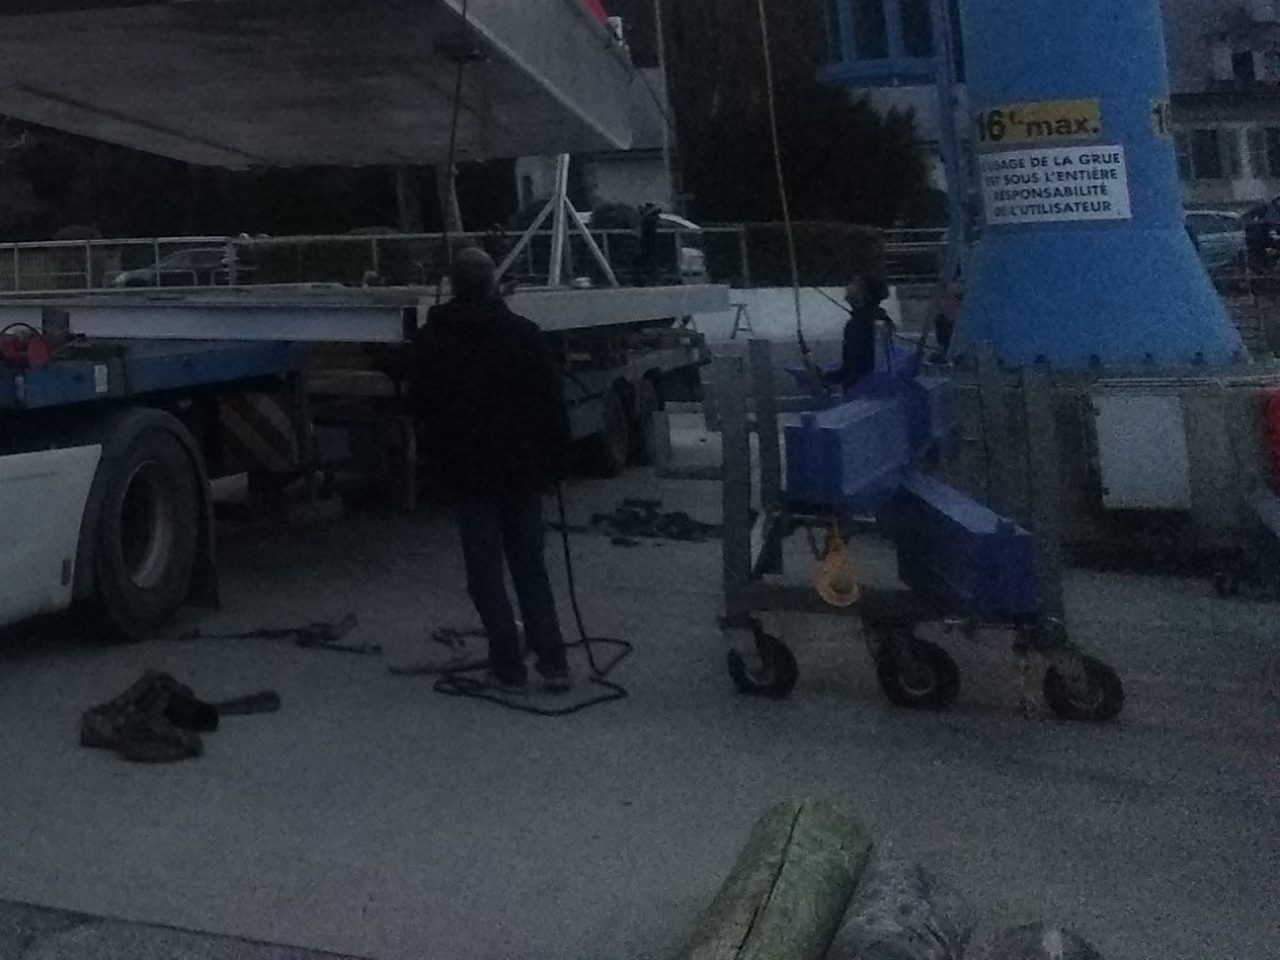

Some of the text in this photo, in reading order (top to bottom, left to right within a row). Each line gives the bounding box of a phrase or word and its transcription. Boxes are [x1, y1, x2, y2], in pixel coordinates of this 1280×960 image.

[1030, 155, 1048, 168] DE
[1054, 153, 1073, 166] LA
[1078, 152, 1121, 165] GRUE
[1004, 172, 1039, 186] SOUS
[1045, 168, 1118, 183] L'ENTIÈRE
[993, 182, 1109, 202] RESPONSABILITÉ
[1010, 200, 1112, 217] L'UTILISATEUR
